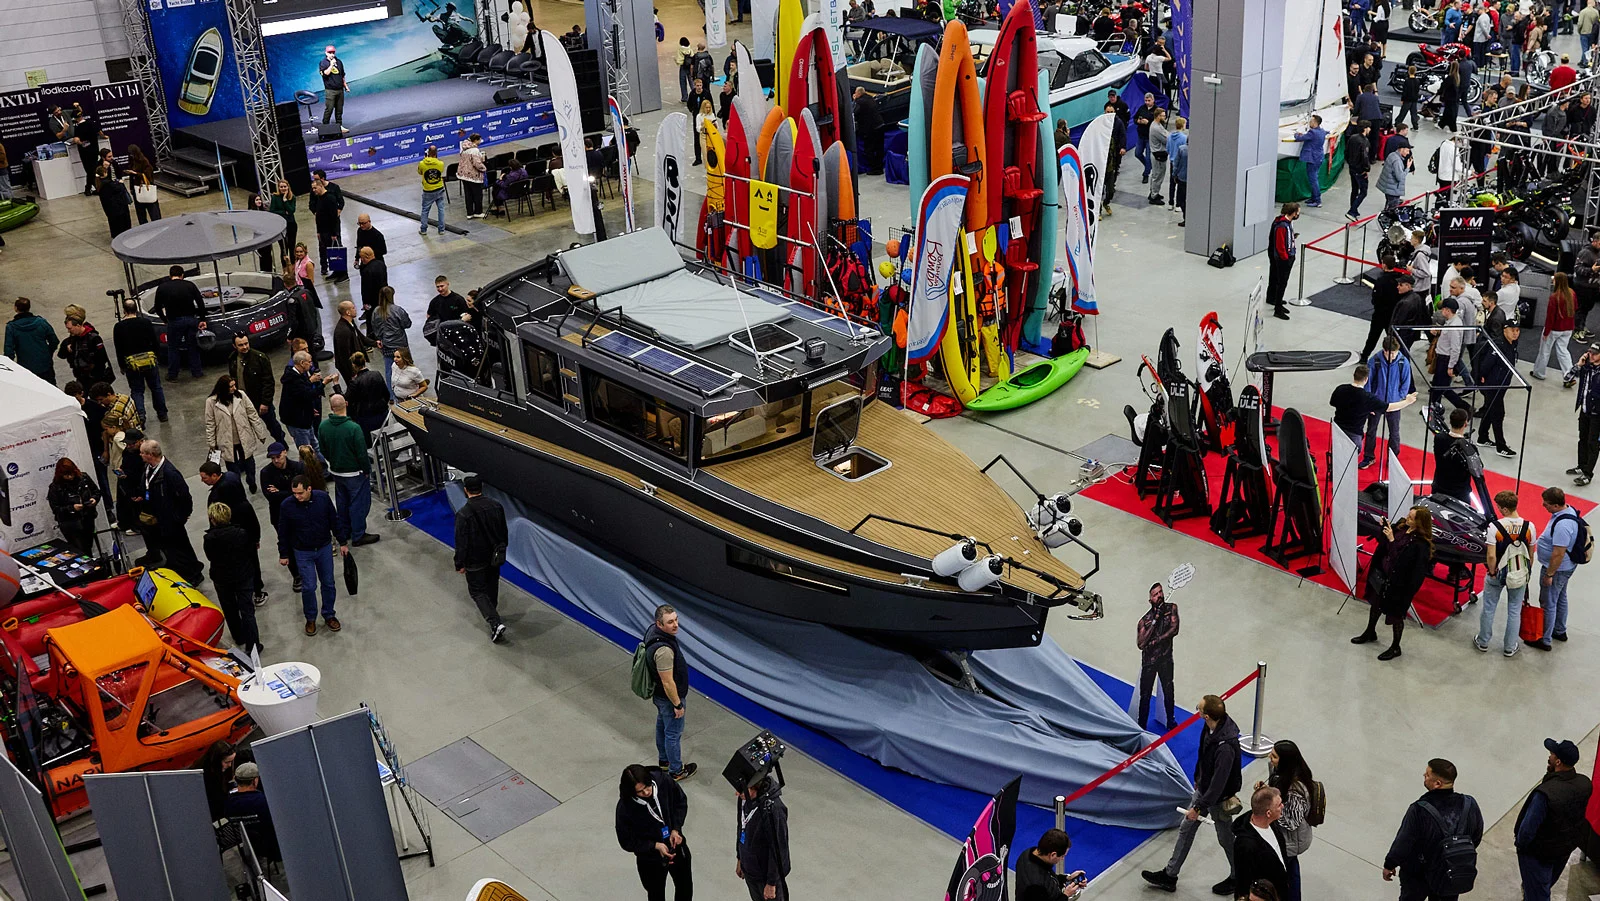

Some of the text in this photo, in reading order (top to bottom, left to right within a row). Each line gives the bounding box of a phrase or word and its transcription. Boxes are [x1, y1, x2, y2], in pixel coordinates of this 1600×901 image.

[94, 83, 140, 102] ЯХТЫ
[1449, 216, 1484, 228] NXM
[254, 314, 284, 331] BBQ BOATS
[438, 350, 456, 367] ZUKI
[38, 463, 57, 472] СТРИ
